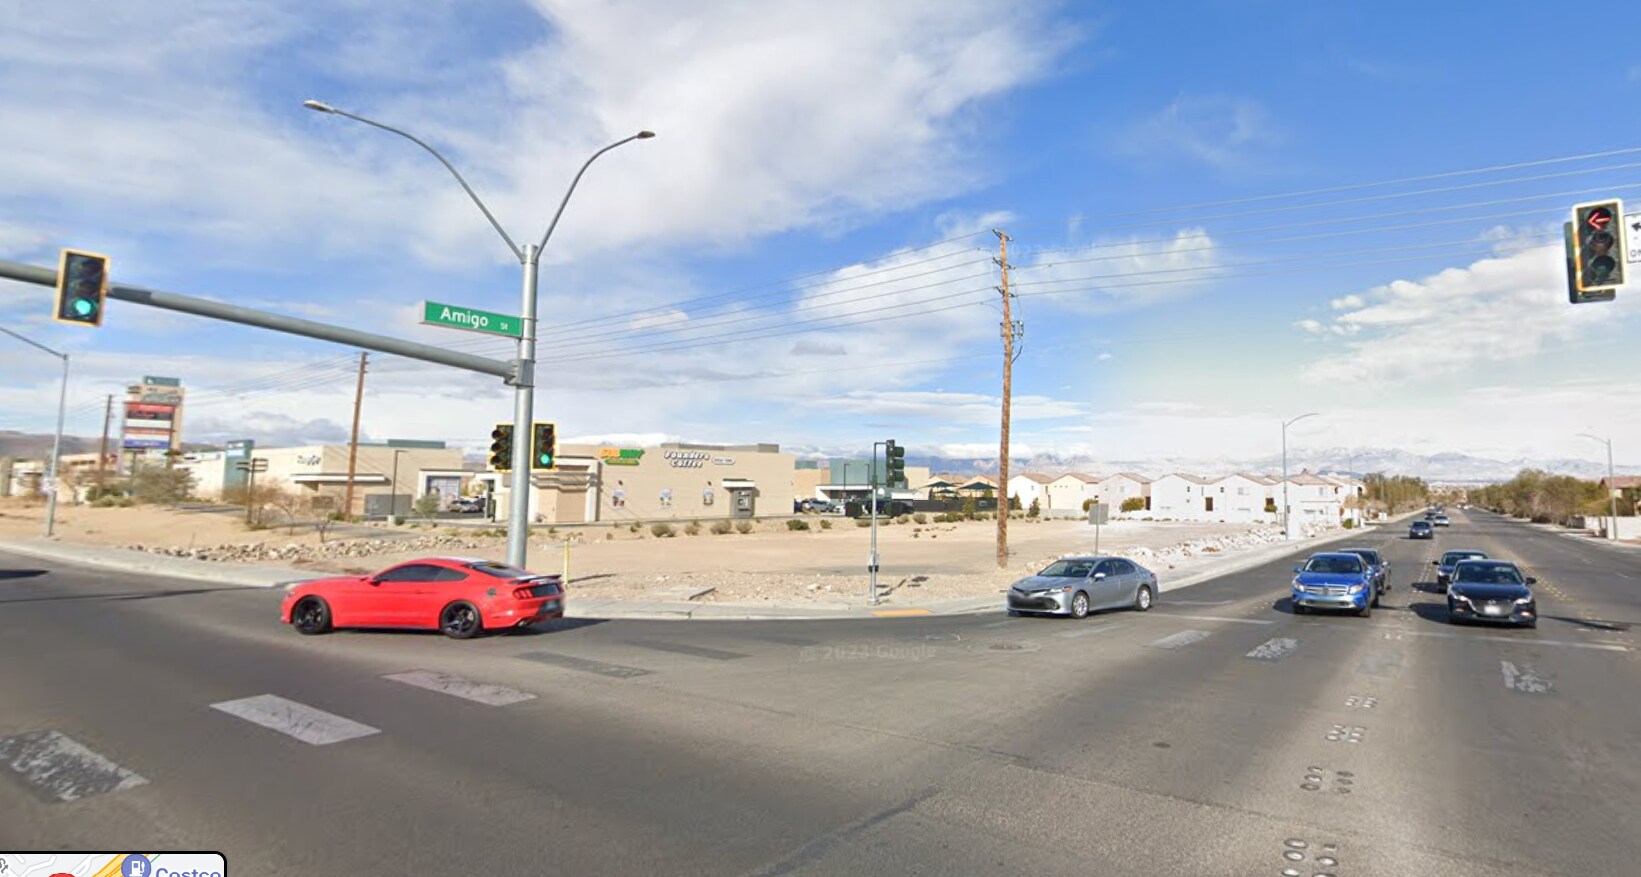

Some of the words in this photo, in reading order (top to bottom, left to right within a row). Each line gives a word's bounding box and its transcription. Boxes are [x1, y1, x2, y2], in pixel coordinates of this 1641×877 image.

[441, 307, 488, 328] Amigo
[500, 322, 508, 330] St
[664, 450, 710, 460] Founders
[671, 459, 703, 469] Coffee
